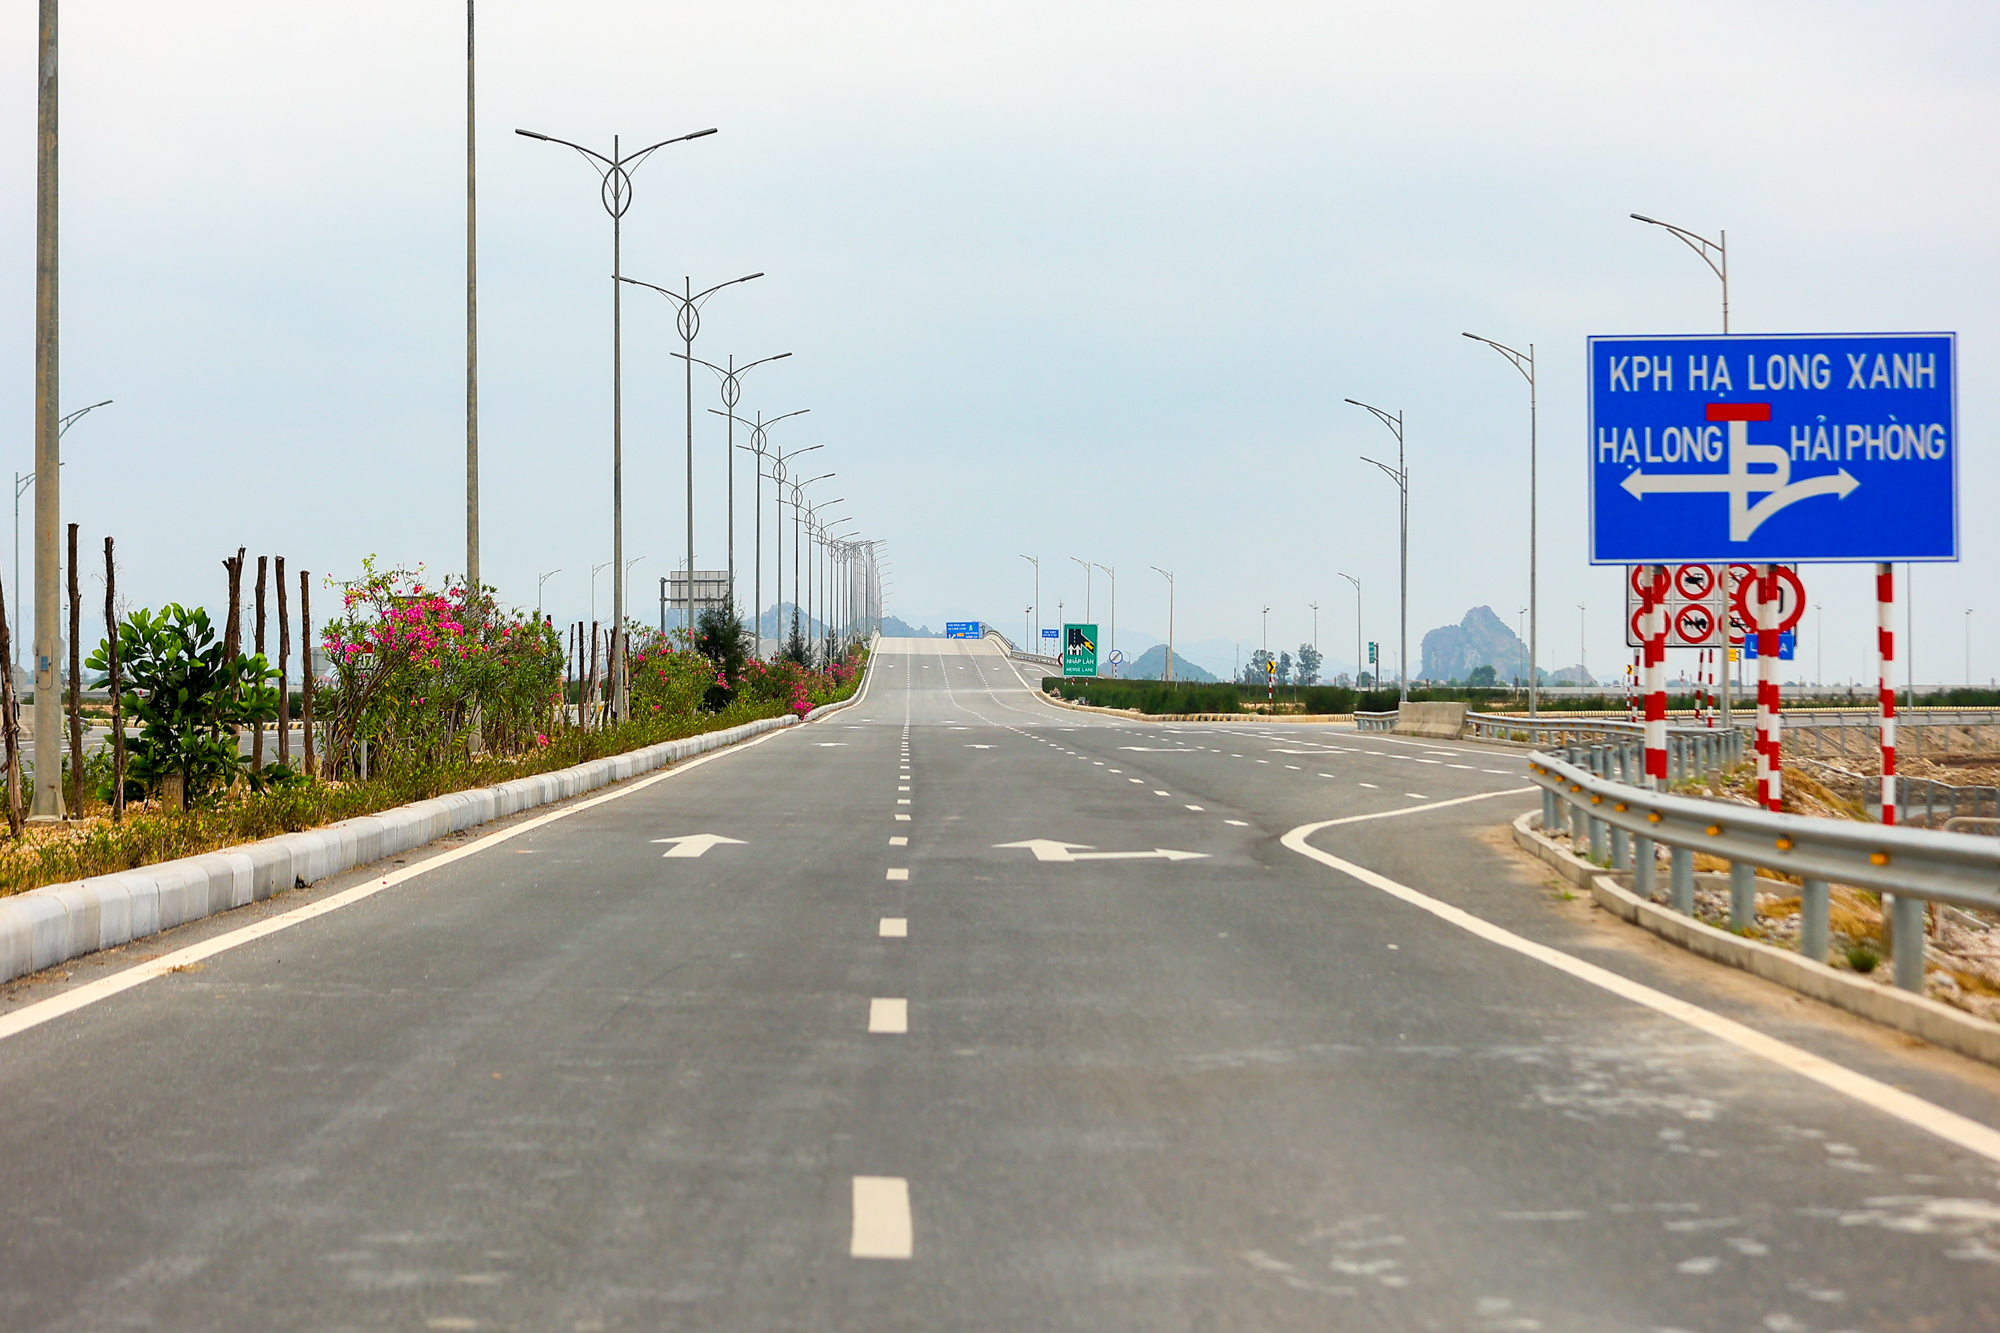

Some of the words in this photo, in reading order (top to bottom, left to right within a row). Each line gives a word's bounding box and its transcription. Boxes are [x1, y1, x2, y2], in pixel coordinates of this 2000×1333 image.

[1609, 355, 1672, 392] KPH
[1689, 355, 1733, 397] HẠ
[1748, 354, 1831, 390] LONG
[1846, 353, 1935, 390] XANH
[1599, 427, 1640, 469] HẠ
[1645, 425, 1723, 463] LONG
[1790, 415, 1840, 461] HẢI
[1846, 415, 1946, 460] PHÒNG
